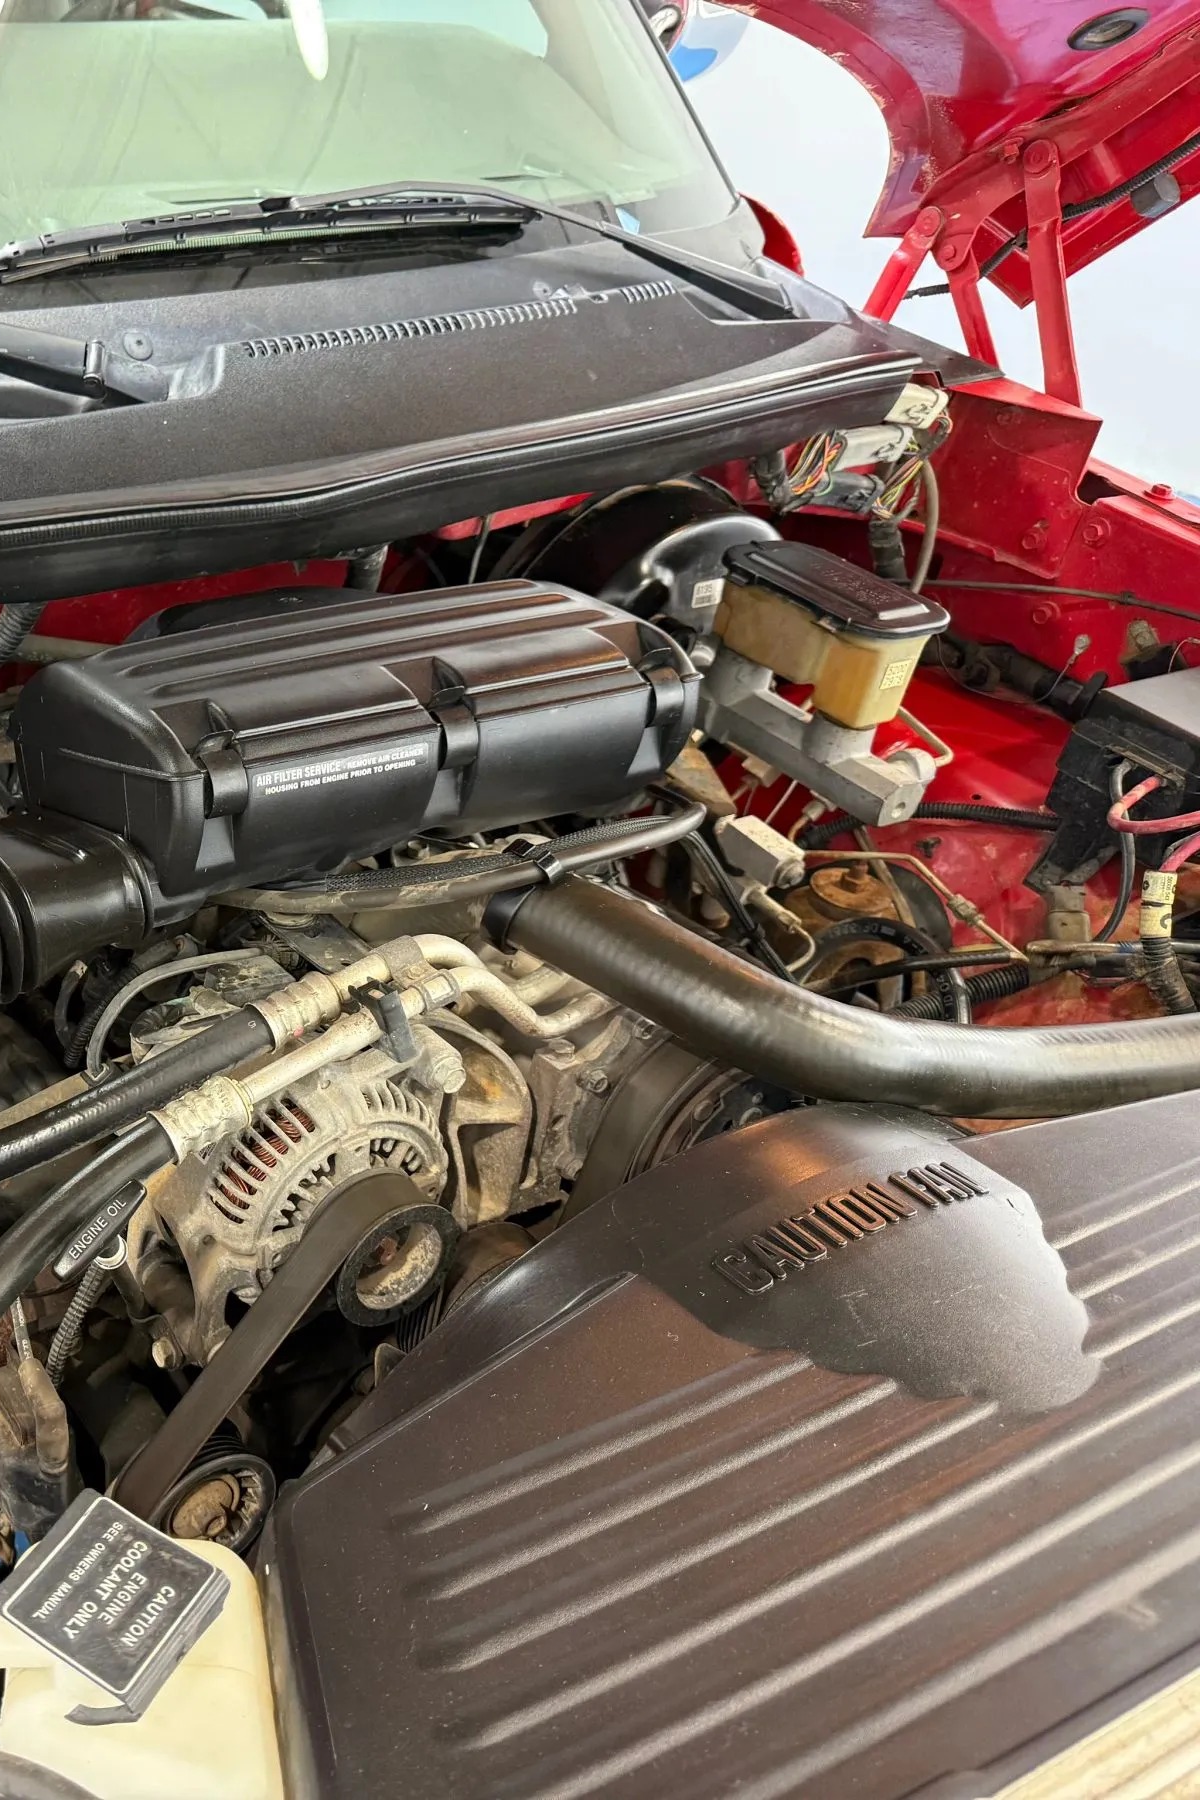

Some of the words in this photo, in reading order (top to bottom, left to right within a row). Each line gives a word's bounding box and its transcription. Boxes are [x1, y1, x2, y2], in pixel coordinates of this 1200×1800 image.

[256, 775, 272, 787] AIR
[274, 769, 302, 784] FILTER
[304, 761, 341, 778] SERVICE
[347, 757, 377, 770] REMOVE
[378, 754, 391, 763] AIR
[392, 748, 423, 761] CLEANER
[265, 783, 299, 795] HOUSING
[300, 778, 321, 788] FROM
[322, 773, 349, 784] ENGINE
[350, 768, 372, 779] PRIOR
[373, 765, 383, 774] TO
[384, 759, 416, 771] OPENING
[68, 1216, 108, 1260] ENGINE
[107, 1199, 127, 1217] OIL
[712, 1182, 918, 1295] CAUTION
[888, 1161, 990, 1210] FAN
[102, 1521, 124, 1542] SEE
[68, 1542, 106, 1581] OWNERS
[95, 1541, 148, 1600] COOLANT
[31, 1581, 71, 1620] MANUAL
[98, 1572, 147, 1625] ENGINE
[119, 1585, 176, 1647] CAUTION
[62, 1601, 98, 1639] ONLY
